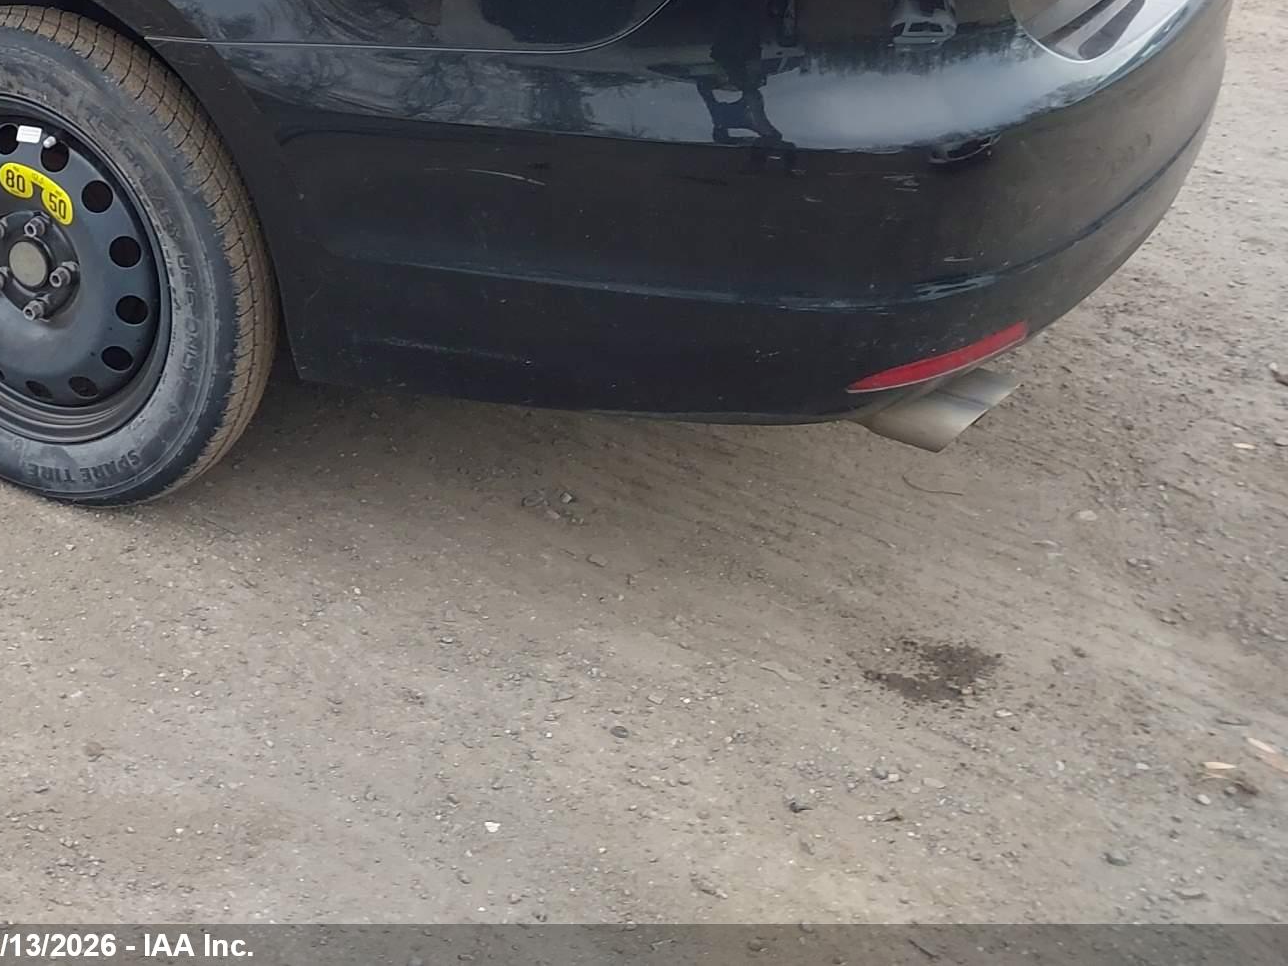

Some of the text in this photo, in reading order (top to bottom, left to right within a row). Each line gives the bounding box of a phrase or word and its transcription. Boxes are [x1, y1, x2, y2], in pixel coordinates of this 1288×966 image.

[5, 168, 26, 194] 80
[48, 192, 68, 221] 50
[26, 449, 143, 484] SPARE TIRE
